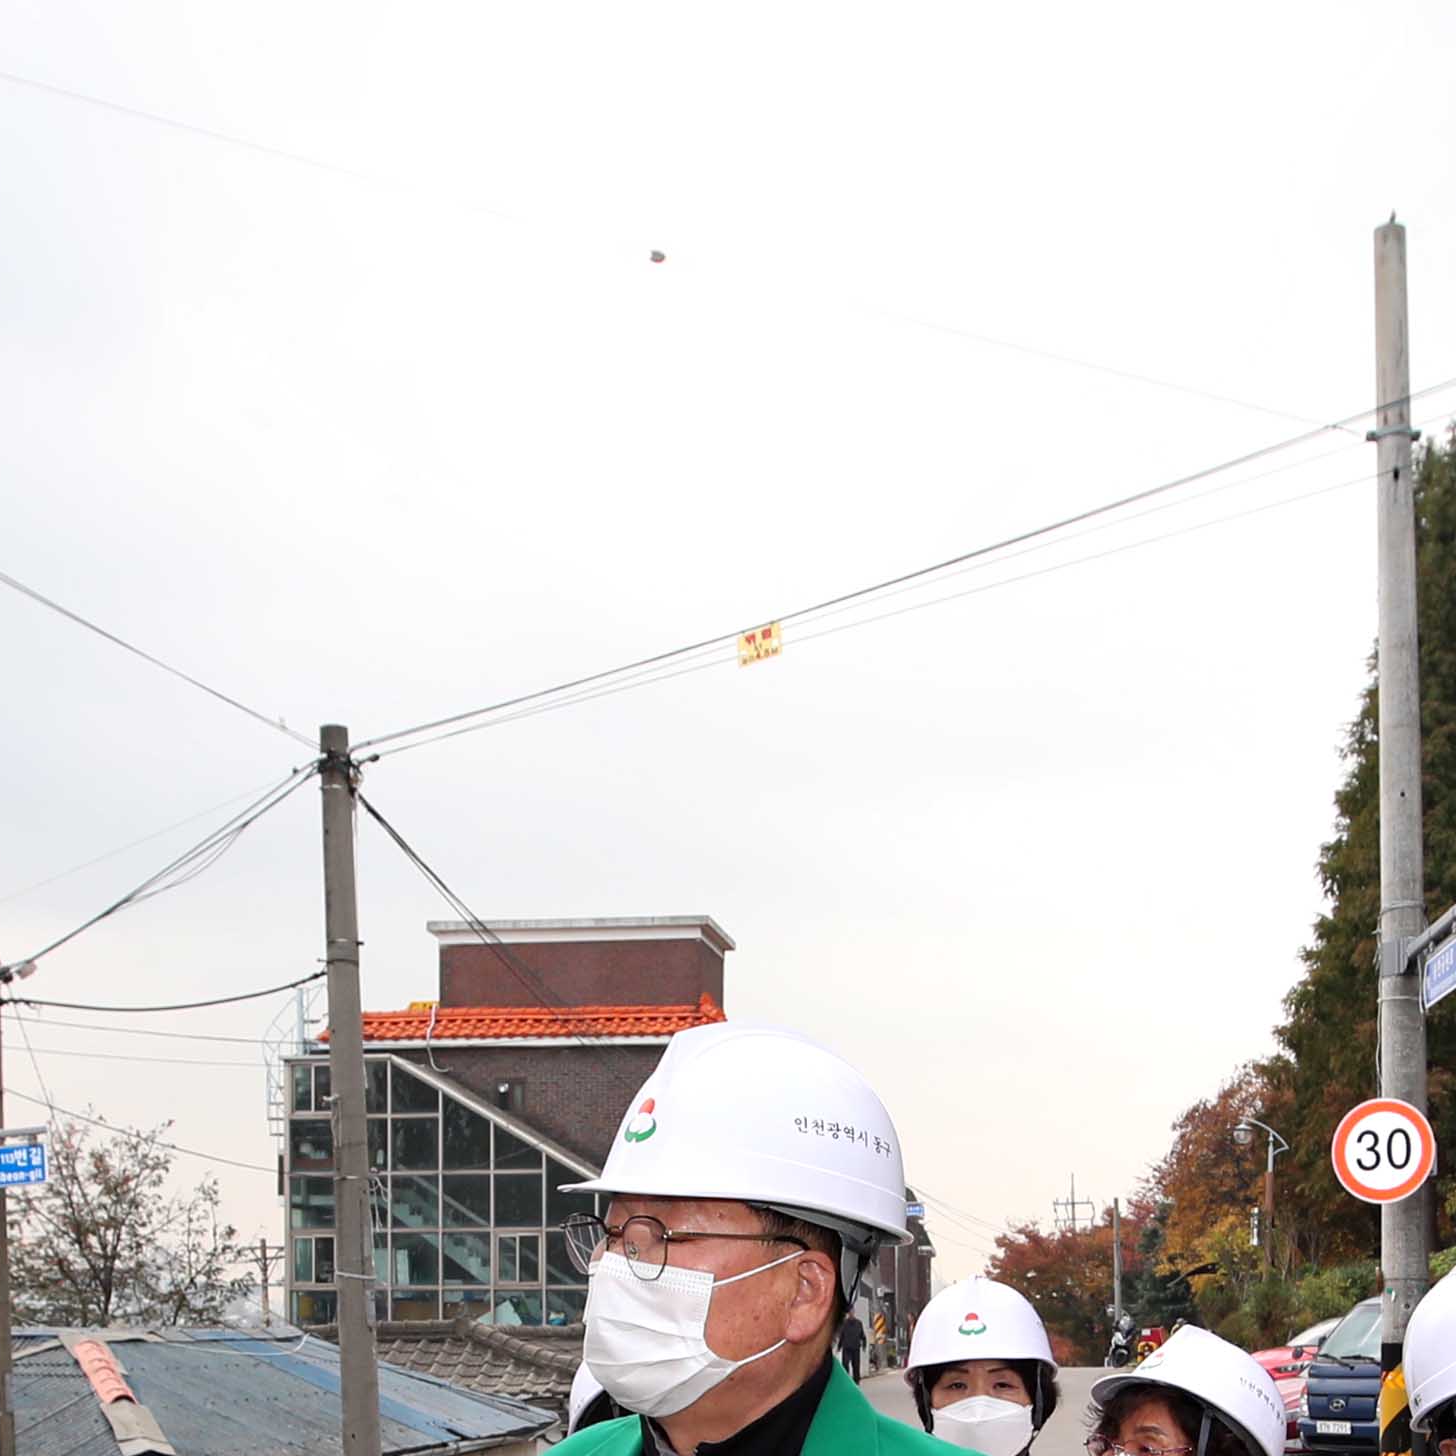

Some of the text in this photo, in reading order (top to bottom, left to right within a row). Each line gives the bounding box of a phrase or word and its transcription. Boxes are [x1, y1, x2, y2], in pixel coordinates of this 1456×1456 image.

[794, 1116, 892, 1158] 인천광역시 동구
[1356, 1128, 1412, 1171] 30
